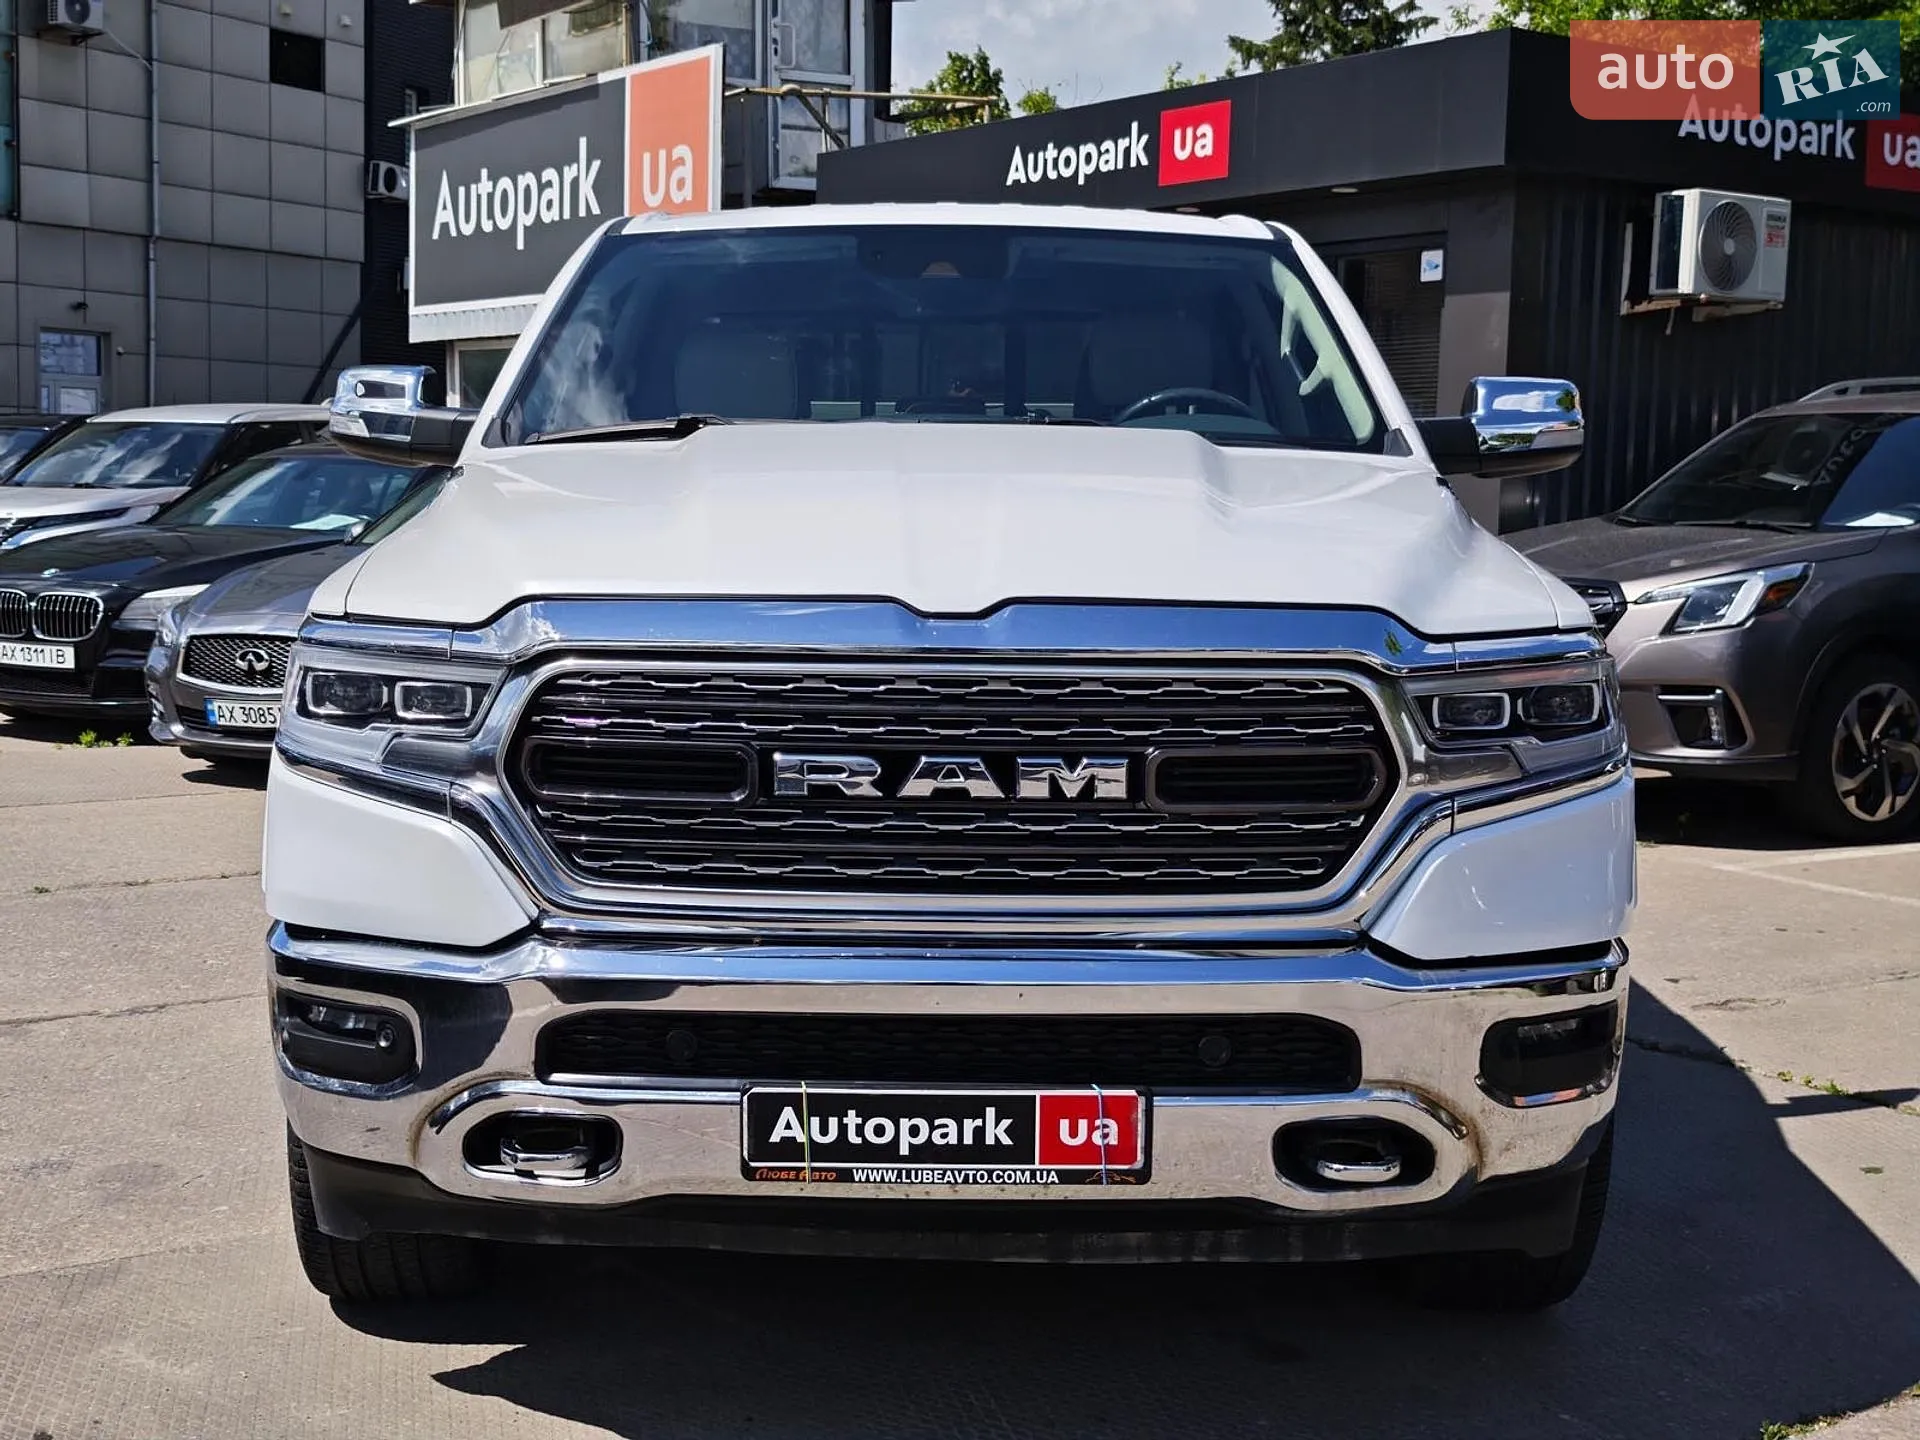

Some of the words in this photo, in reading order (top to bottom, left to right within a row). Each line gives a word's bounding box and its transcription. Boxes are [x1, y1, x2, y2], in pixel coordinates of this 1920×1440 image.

[1006, 121, 1149, 186] Autopark
[1173, 123, 1213, 161] ua
[1677, 92, 1855, 161] Autopark
[1884, 132, 1920, 168] ua
[432, 136, 601, 250] Autopark
[643, 144, 693, 208] ua
[217, 705, 237, 723] AX
[239, 707, 277, 724] 3085
[774, 753, 1128, 799] RAM
[768, 1106, 1014, 1155] Autopark
[1060, 1117, 1118, 1146] ua
[853, 1169, 1059, 1184] WWW.LUBEAVTO.COM.UA
